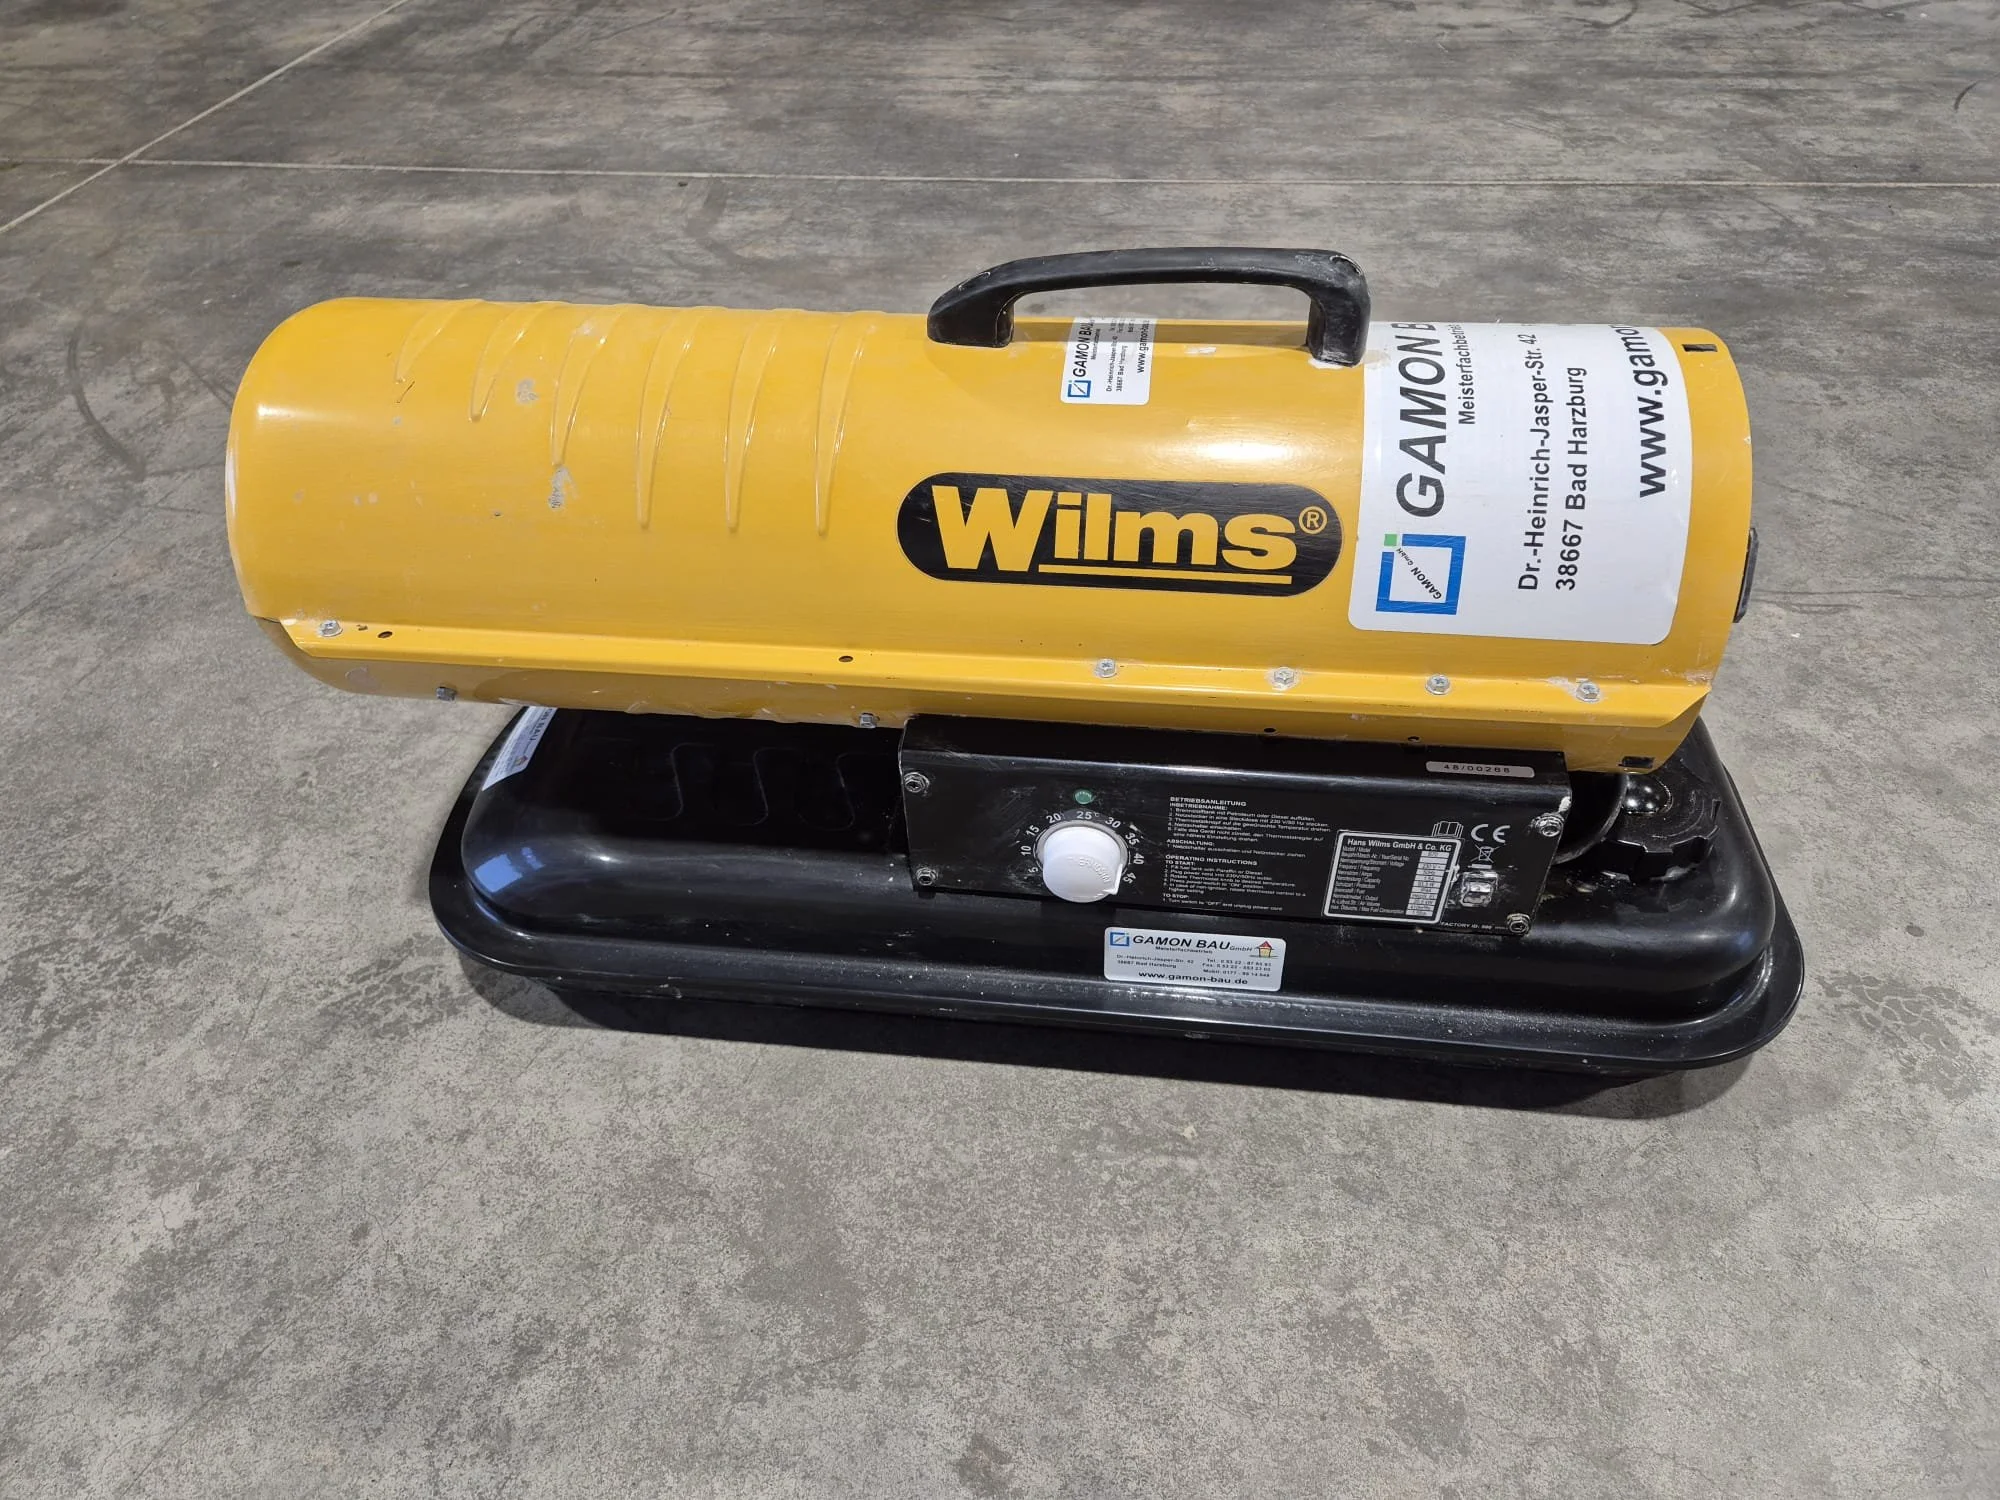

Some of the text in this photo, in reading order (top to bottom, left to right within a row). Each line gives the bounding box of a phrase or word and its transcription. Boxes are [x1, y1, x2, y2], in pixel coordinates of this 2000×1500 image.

[1072, 336, 1090, 378] GAMON
[1117, 365, 1125, 376] Bad
[1395, 334, 1446, 517] GAMON
[1518, 333, 1553, 590] Dr.-Heinrich-Jasper-Str. 42
[1555, 366, 1588, 591] 38667 Bad Harzburg
[1410, 566, 1443, 600] GAMON
[1170, 796, 1247, 807] BETRIEBSANLEITUNG
[1170, 802, 1228, 811] INBETRIEBNAHME:
[1045, 812, 1061, 824] 20
[1076, 810, 1093, 820] 25
[1104, 816, 1122, 829] 30
[1025, 824, 1040, 837] 15
[1125, 832, 1140, 845] 35
[1347, 838, 1367, 846] Hans
[1368, 840, 1391, 848] Wilms
[1392, 841, 1417, 849] GmbH
[1439, 844, 1453, 852] KG
[1020, 845, 1032, 857] 10
[1133, 852, 1145, 865] 40
[1165, 854, 1258, 866] OPERATING INSTRUCTIONS
[1123, 872, 1137, 884] 45
[1132, 935, 1193, 948] GAMON
[1195, 939, 1231, 950] BAU
[1138, 971, 1249, 985] www.gamon-bau.de
